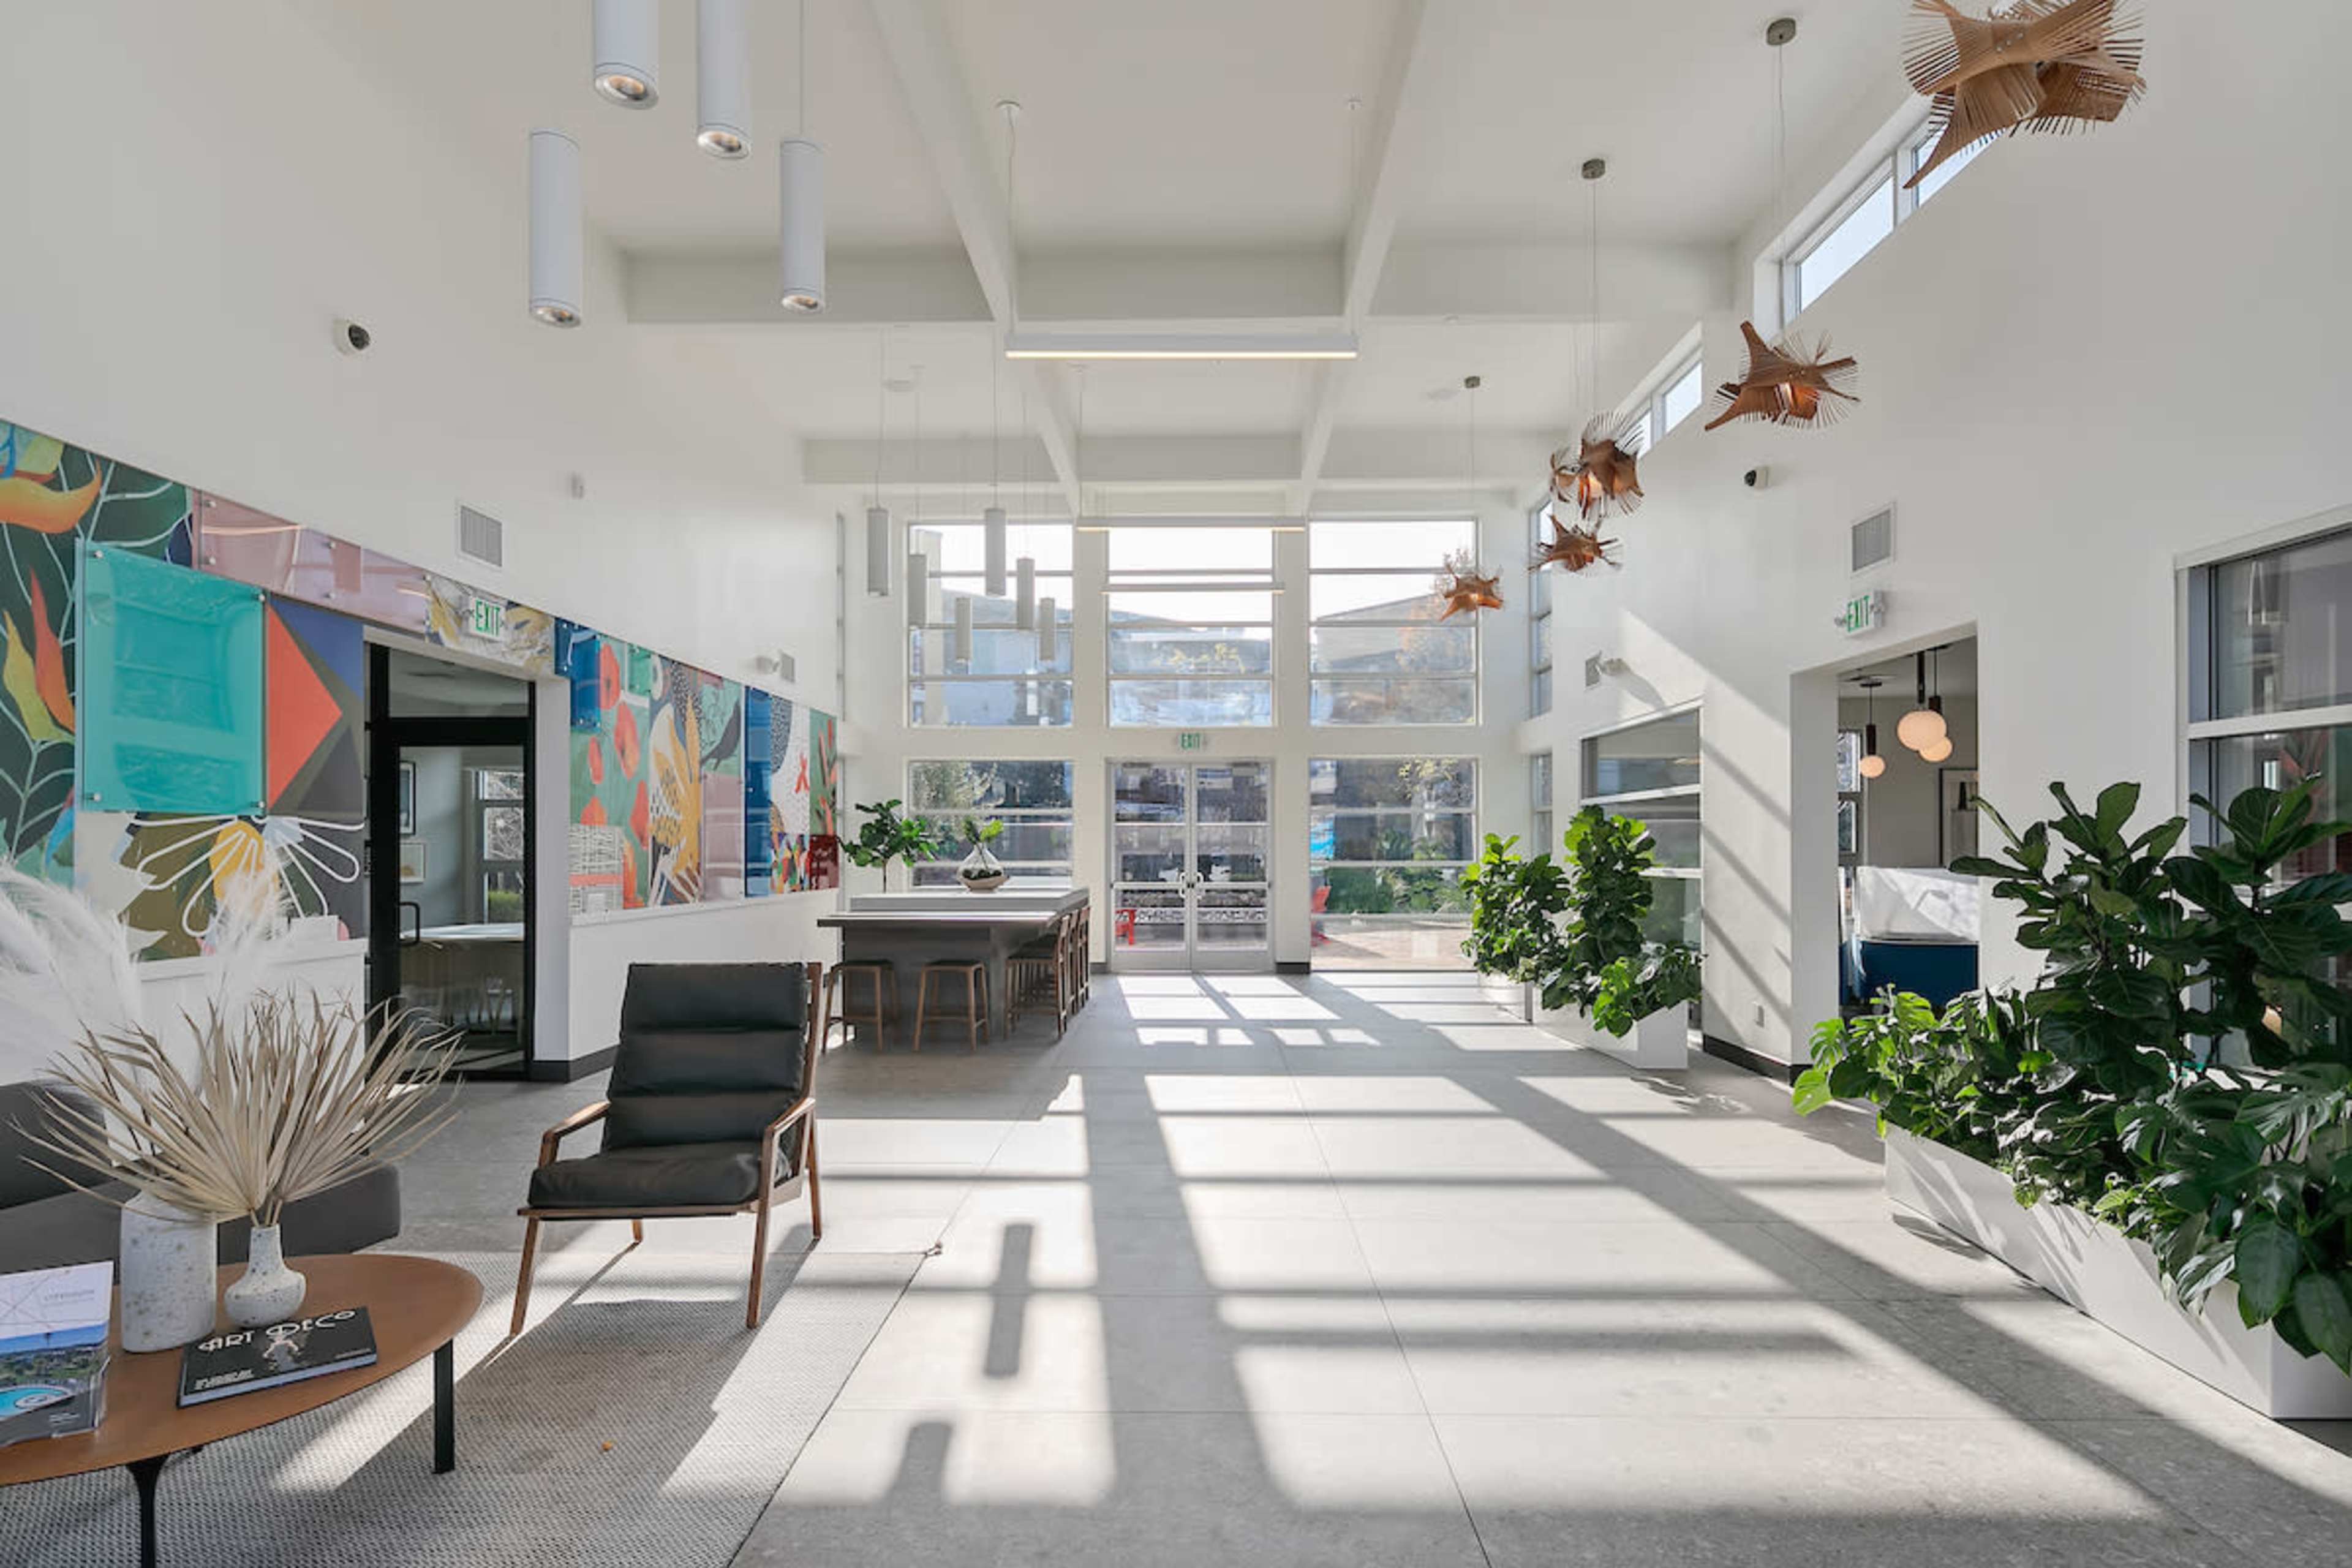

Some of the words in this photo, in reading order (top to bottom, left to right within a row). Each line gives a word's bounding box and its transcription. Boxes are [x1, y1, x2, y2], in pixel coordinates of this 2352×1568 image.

[475, 600, 500, 636] EXIT
[1846, 595, 1870, 633] EXIT
[1181, 733, 1200, 748] EXIT
[198, 1330, 255, 1352] ART
